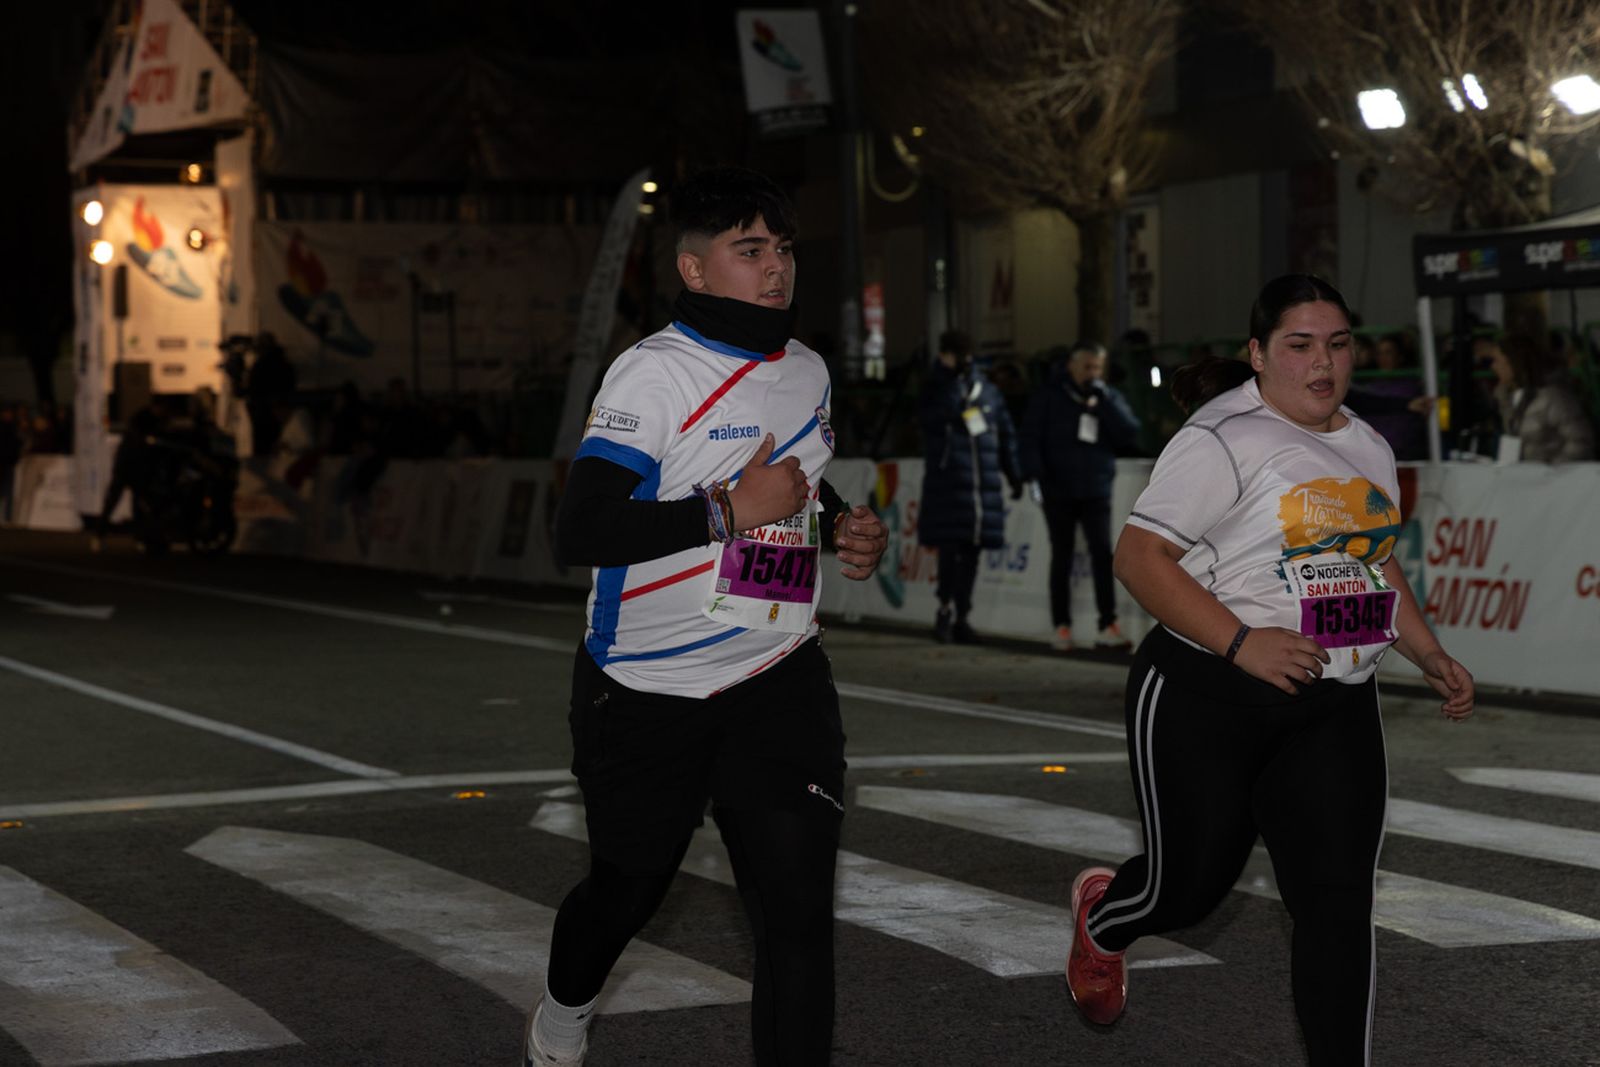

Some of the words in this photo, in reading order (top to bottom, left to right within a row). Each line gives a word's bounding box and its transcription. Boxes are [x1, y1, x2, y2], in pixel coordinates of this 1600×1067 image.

[596, 409, 640, 430] LCAUDETE
[720, 425, 761, 440] alexen
[767, 529, 803, 546] ANTÓN
[1427, 518, 1498, 569] SAN
[1317, 566, 1351, 580] NOCHE
[1307, 583, 1330, 597] SAN
[1332, 577, 1367, 595] ANTÓN
[1423, 562, 1533, 632] ANTÓN
[1311, 594, 1388, 635] 15345
